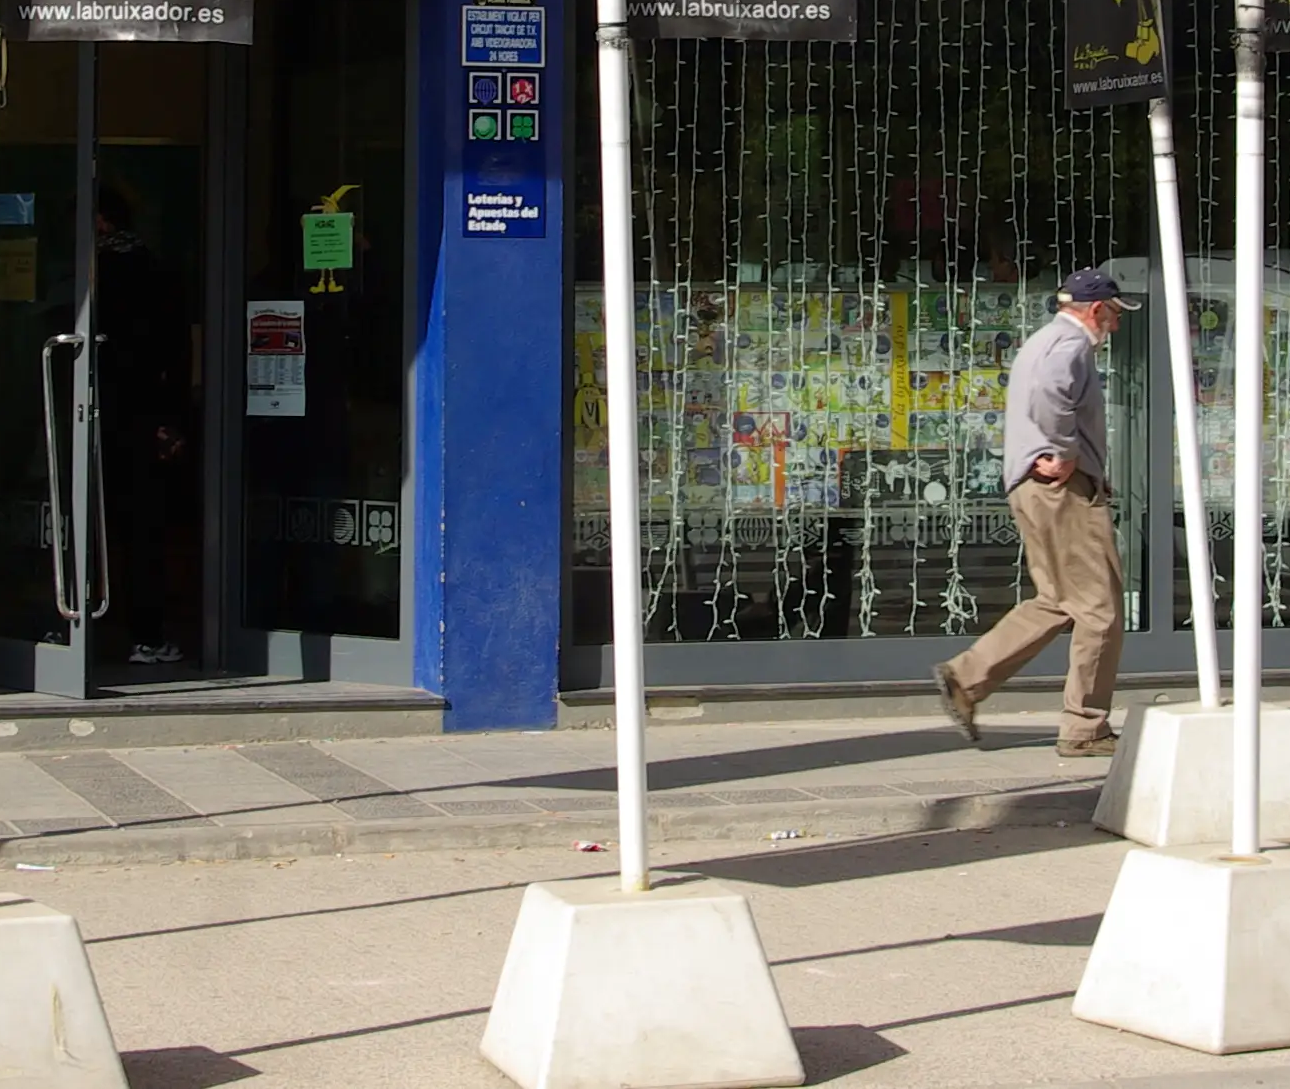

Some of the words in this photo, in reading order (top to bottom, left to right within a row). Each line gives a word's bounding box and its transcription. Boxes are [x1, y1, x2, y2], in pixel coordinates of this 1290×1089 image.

[19, 0, 224, 24] www.labruixador.es
[467, 193, 513, 205] Loterías
[514, 196, 523, 207] y
[468, 207, 520, 220] Apuestas
[520, 206, 539, 218] del
[467, 219, 507, 231] Estado
